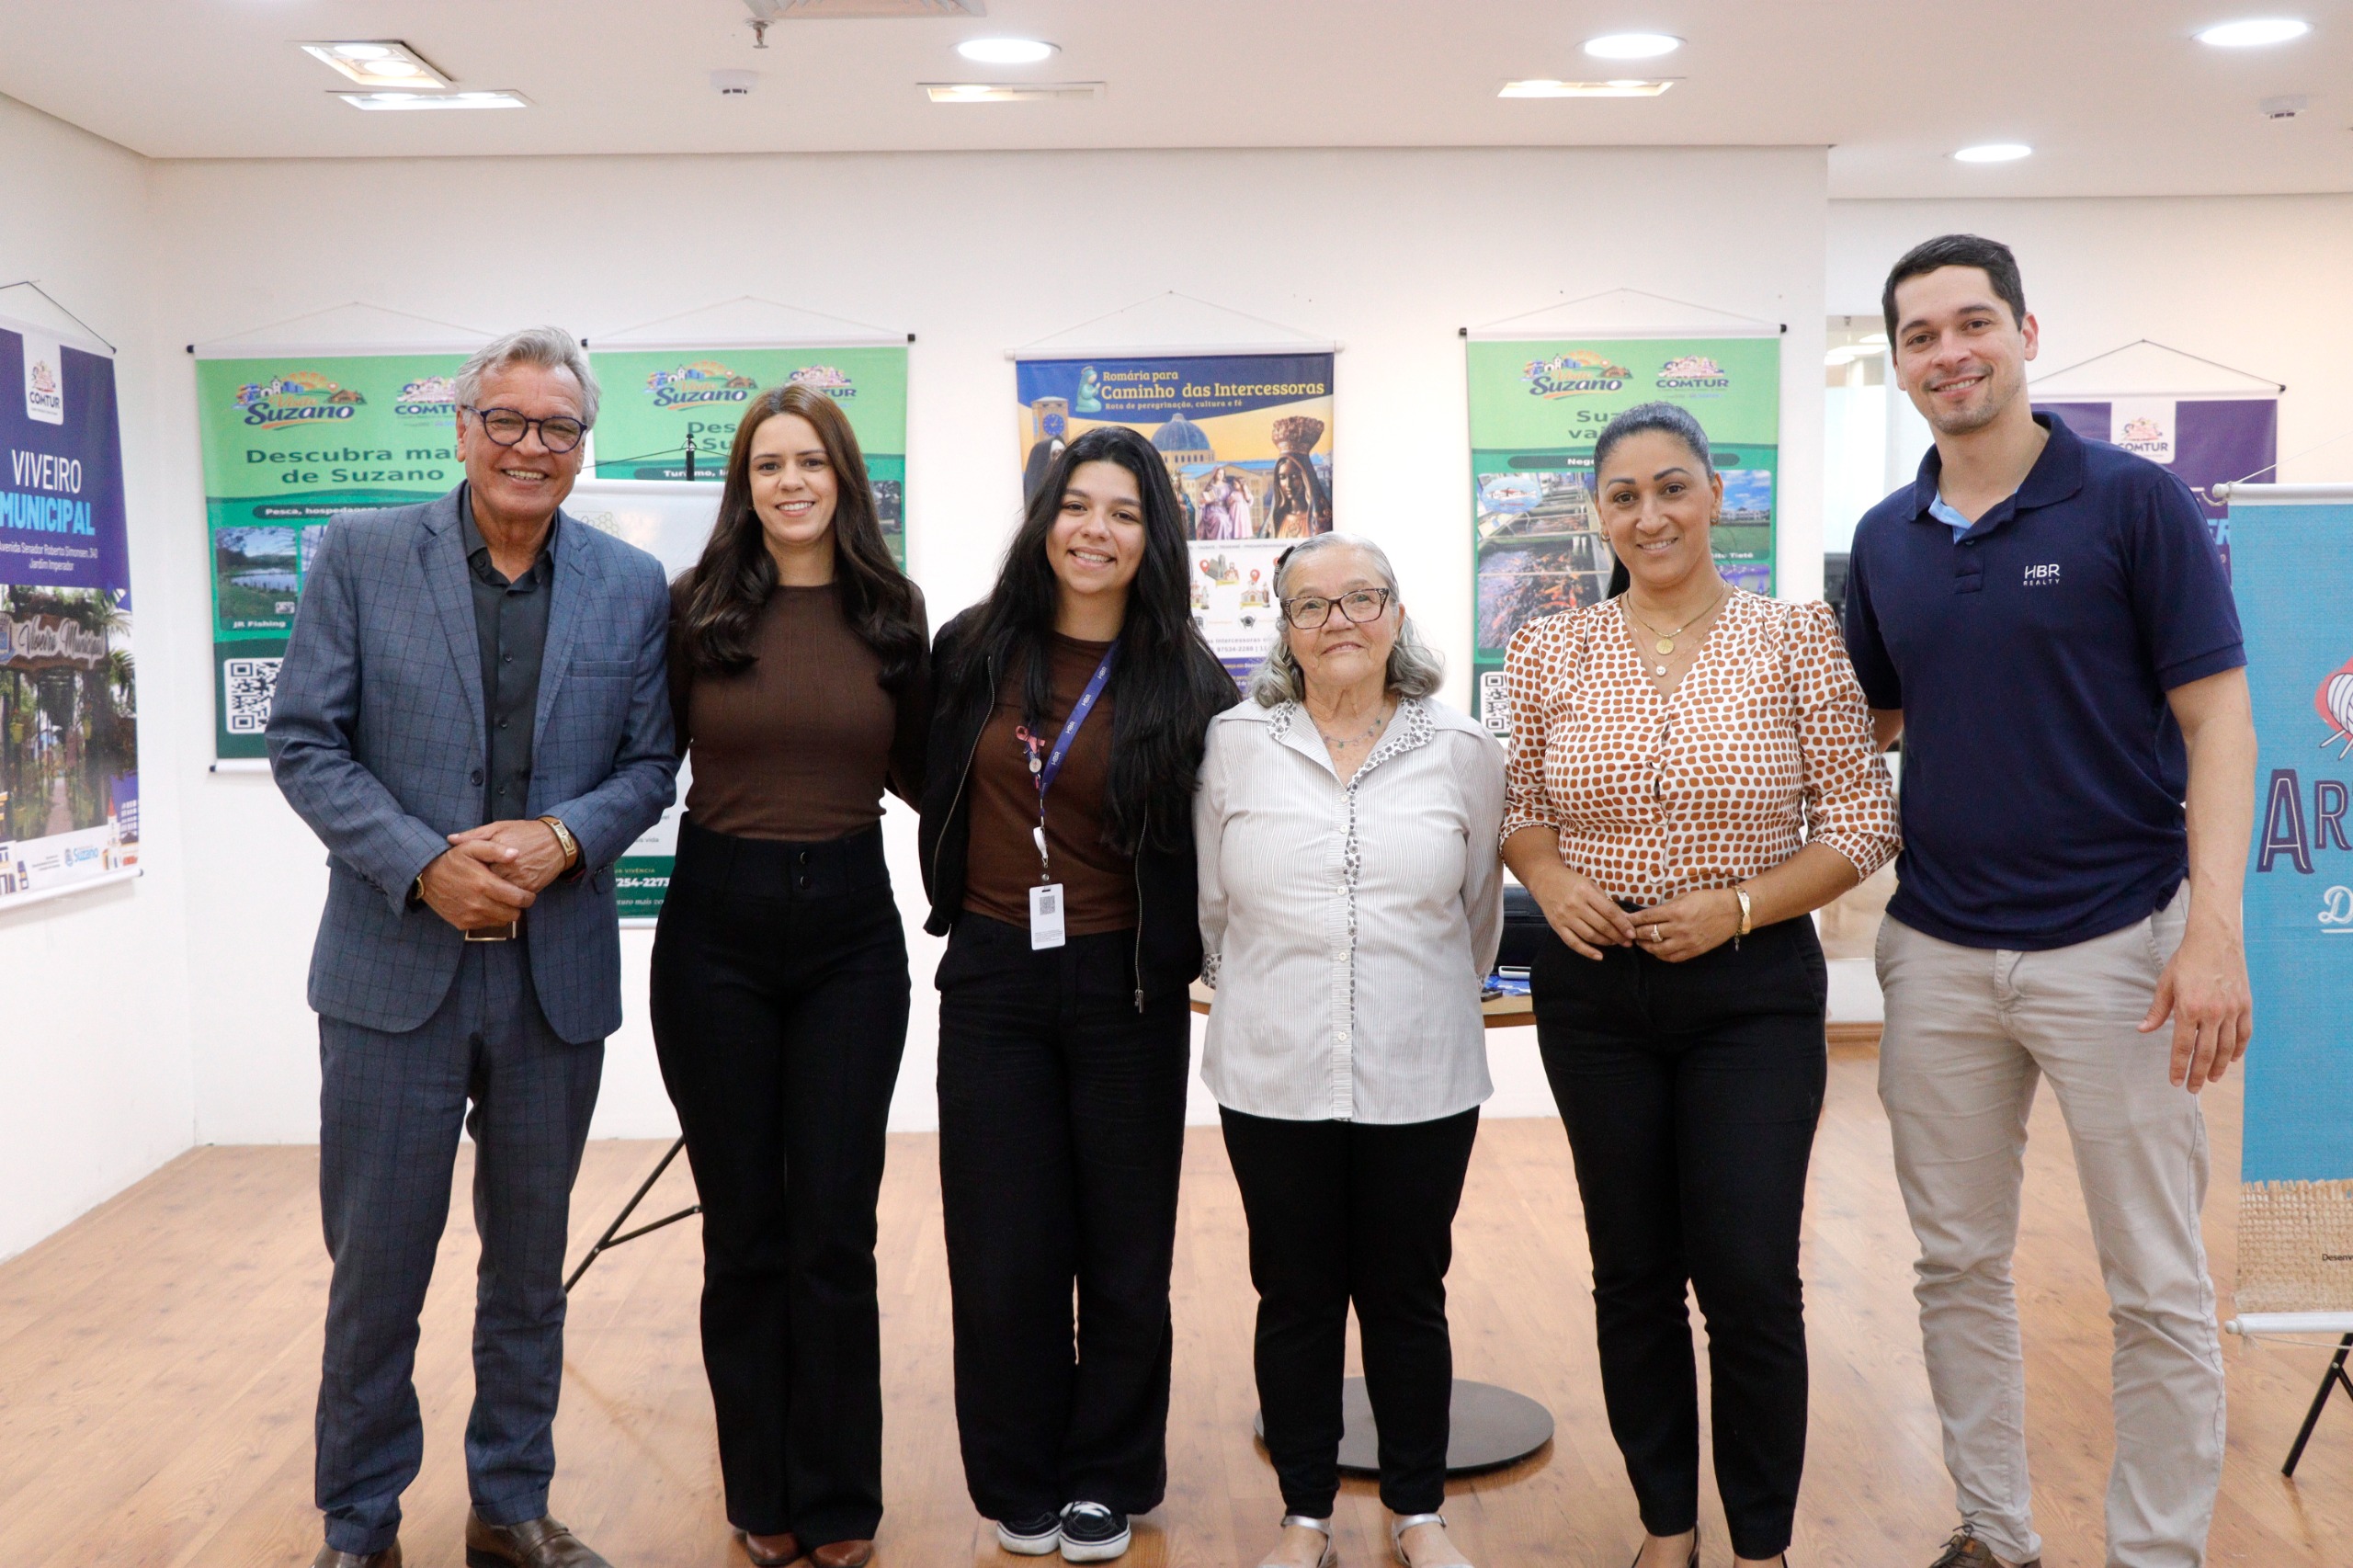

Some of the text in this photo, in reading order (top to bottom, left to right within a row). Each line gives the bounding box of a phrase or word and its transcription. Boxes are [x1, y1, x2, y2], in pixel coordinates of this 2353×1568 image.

[1103, 369, 1178, 382] Romária para
[1101, 383, 1324, 399] Caminho das Intercessoras
[1529, 376, 1622, 395] Suzano
[1656, 379, 1730, 388] COMTUR
[29, 392, 61, 409] COMTUR
[654, 387, 747, 406] Suzano
[820, 389, 857, 397] TUR
[244, 403, 355, 426] Suzano
[394, 403, 457, 415] COMT
[688, 422, 737, 433] Des
[702, 437, 732, 450] Su
[246, 445, 458, 463] Descubra mai
[11, 449, 82, 494] VIVEIRO
[281, 468, 444, 483] de Suzano
[0, 491, 96, 536] MUNICIPAL
[2024, 563, 2061, 579] HBR
[2023, 578, 2060, 586] REALTY
[247, 619, 286, 629] Fishing
[1081, 694, 1091, 707] HBR
[1065, 721, 1075, 734] HBR
[1051, 751, 1061, 766] HBR
[2256, 768, 2353, 874] AR
[616, 877, 670, 888] 254-2273
